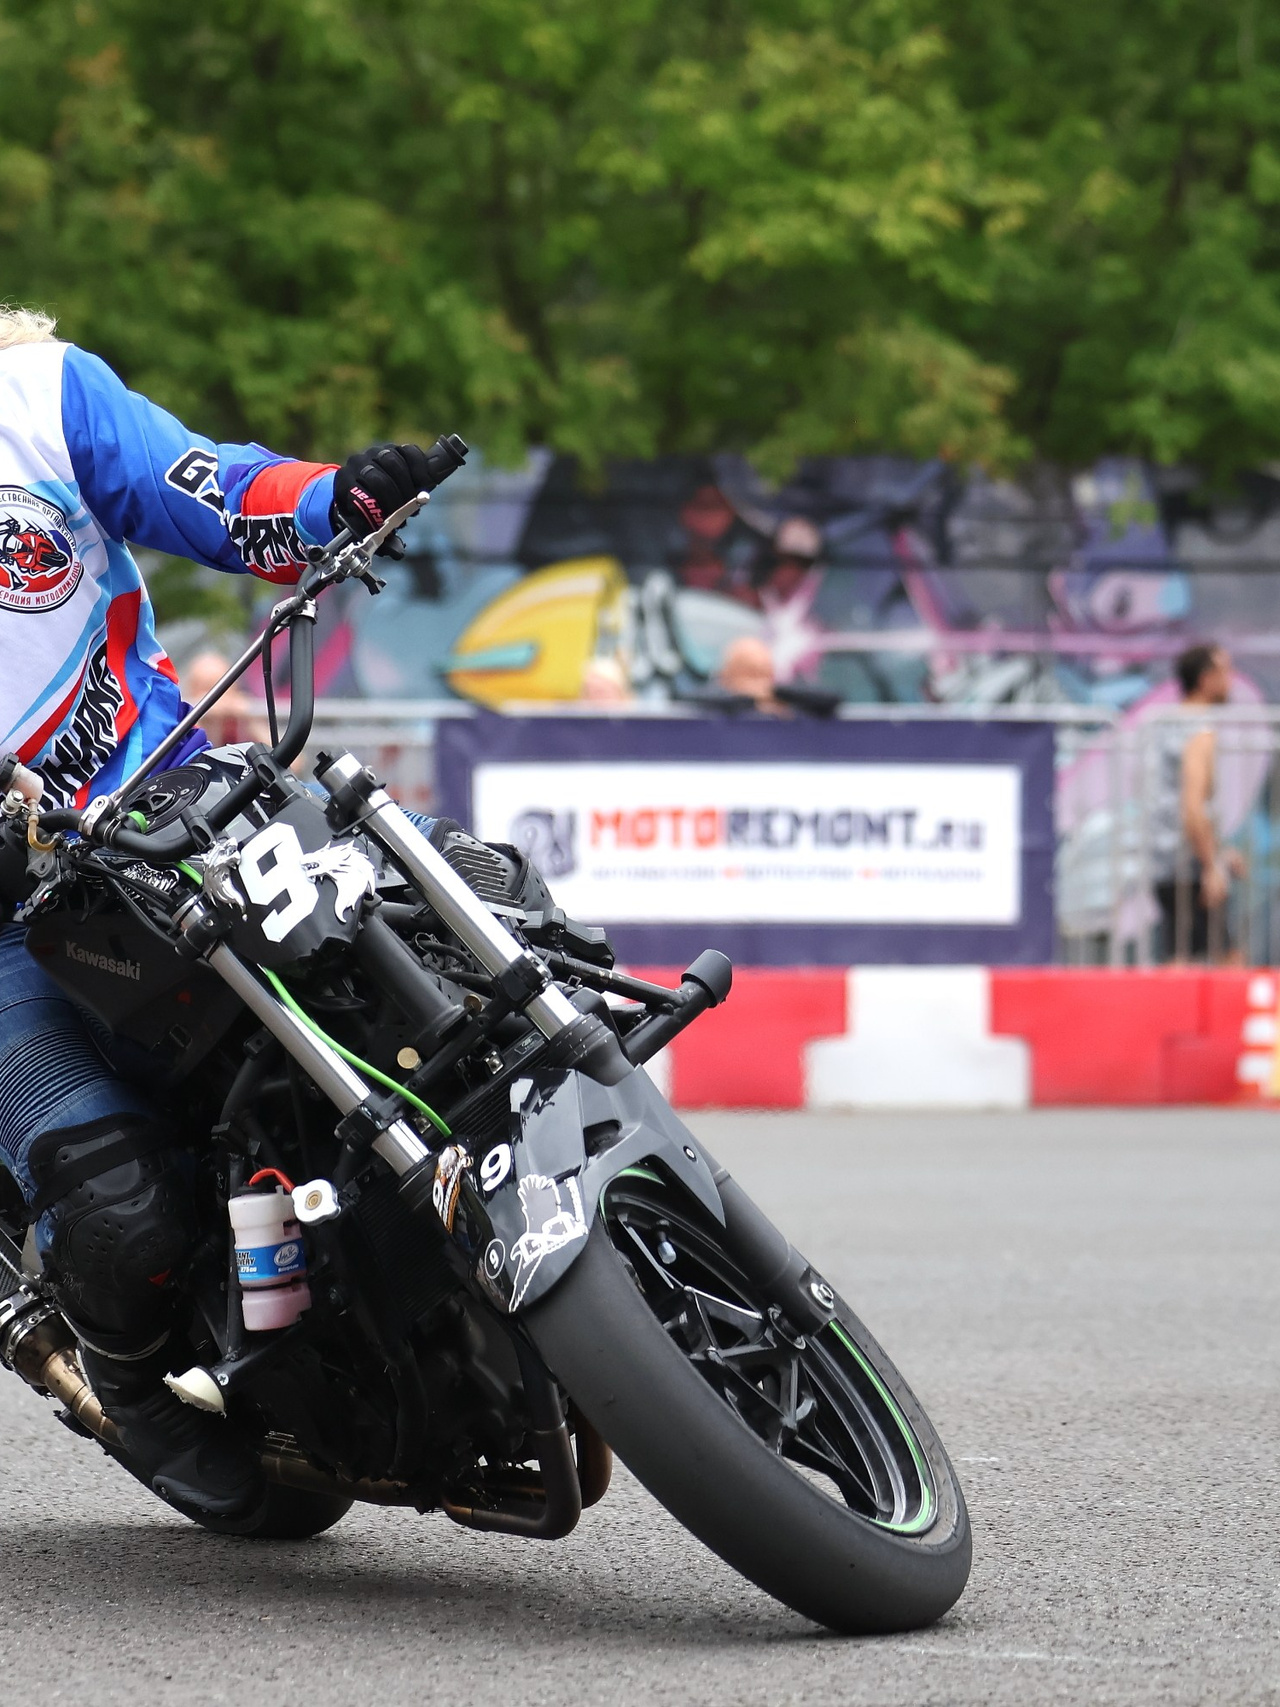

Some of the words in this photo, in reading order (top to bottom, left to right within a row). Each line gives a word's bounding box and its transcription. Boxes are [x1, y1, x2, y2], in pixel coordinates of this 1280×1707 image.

[35, 560, 81, 605] МОТОДЖИМХАНЫ
[238, 821, 320, 943] 9
[65, 940, 141, 981] Kawasaki
[480, 1143, 511, 1192] 9
[489, 1248, 499, 1270] 9
